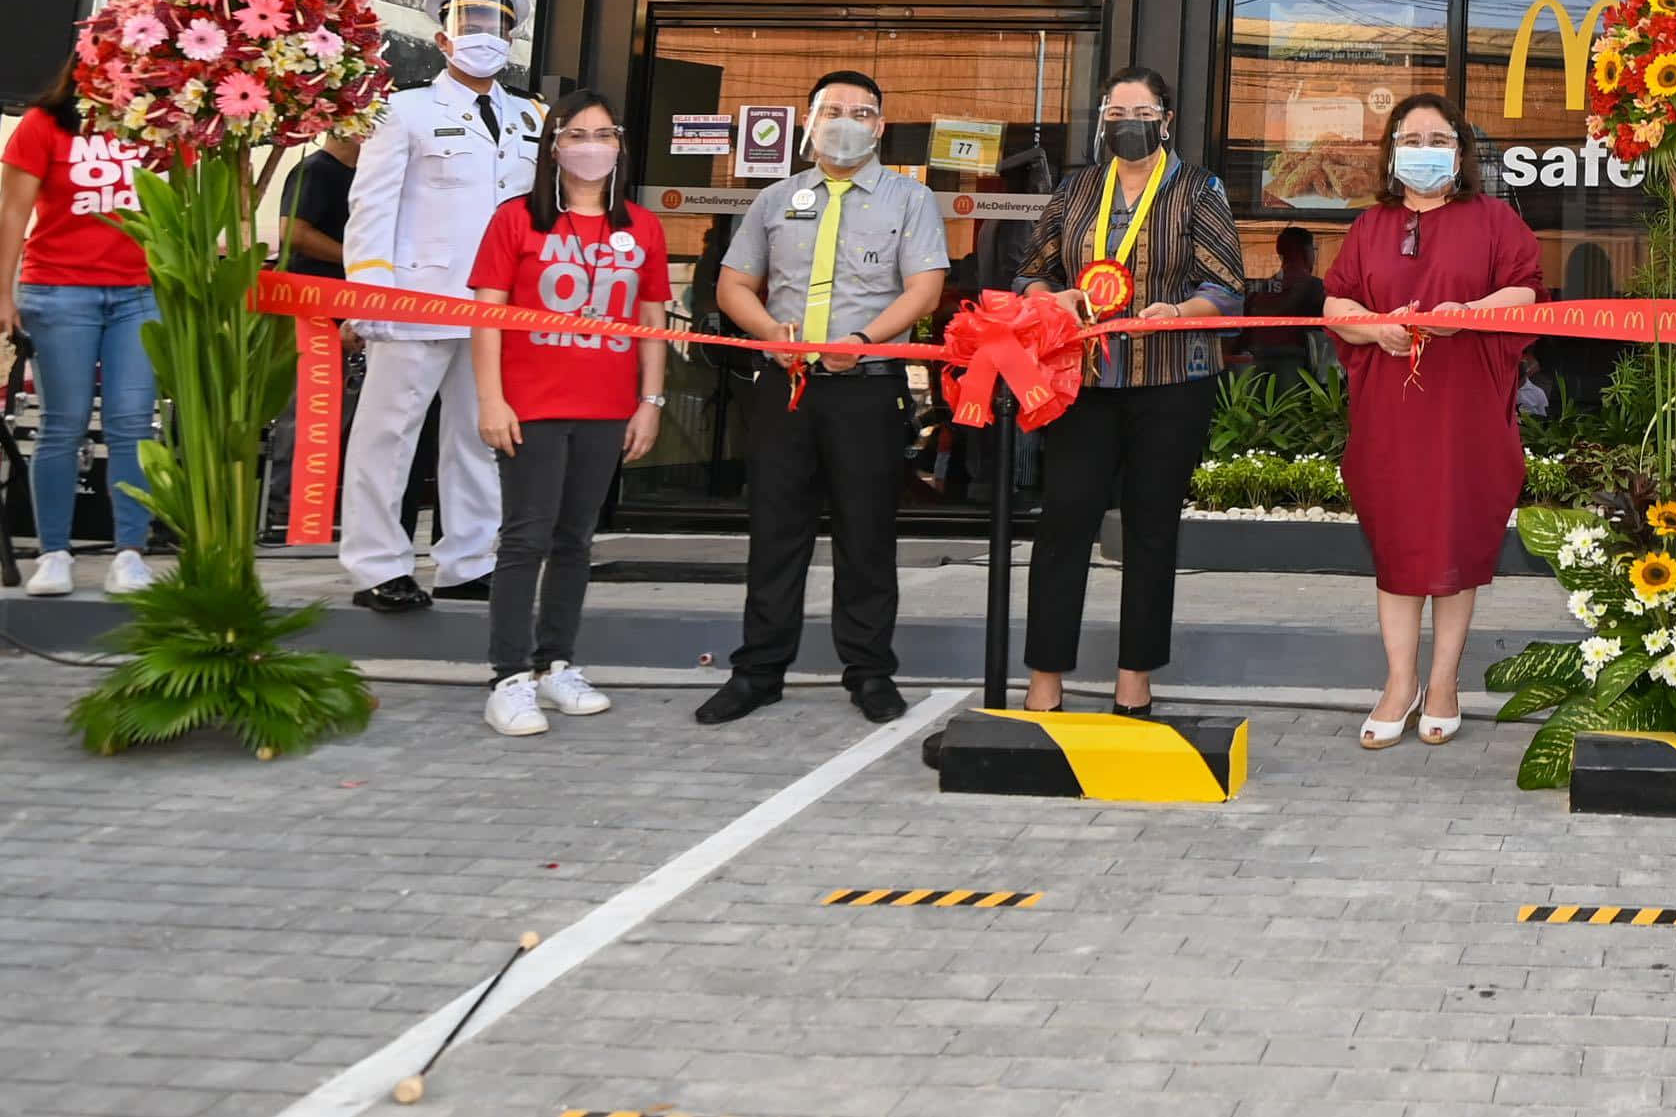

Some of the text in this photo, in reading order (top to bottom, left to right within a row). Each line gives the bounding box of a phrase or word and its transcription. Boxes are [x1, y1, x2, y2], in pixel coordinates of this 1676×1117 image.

[69, 135, 150, 163] Mc
[958, 142, 973, 155] 77
[71, 186, 142, 215] ald
[684, 195, 753, 207] McDelivery.co
[976, 202, 1047, 213] McDelivery.co
[539, 234, 646, 269] McD
